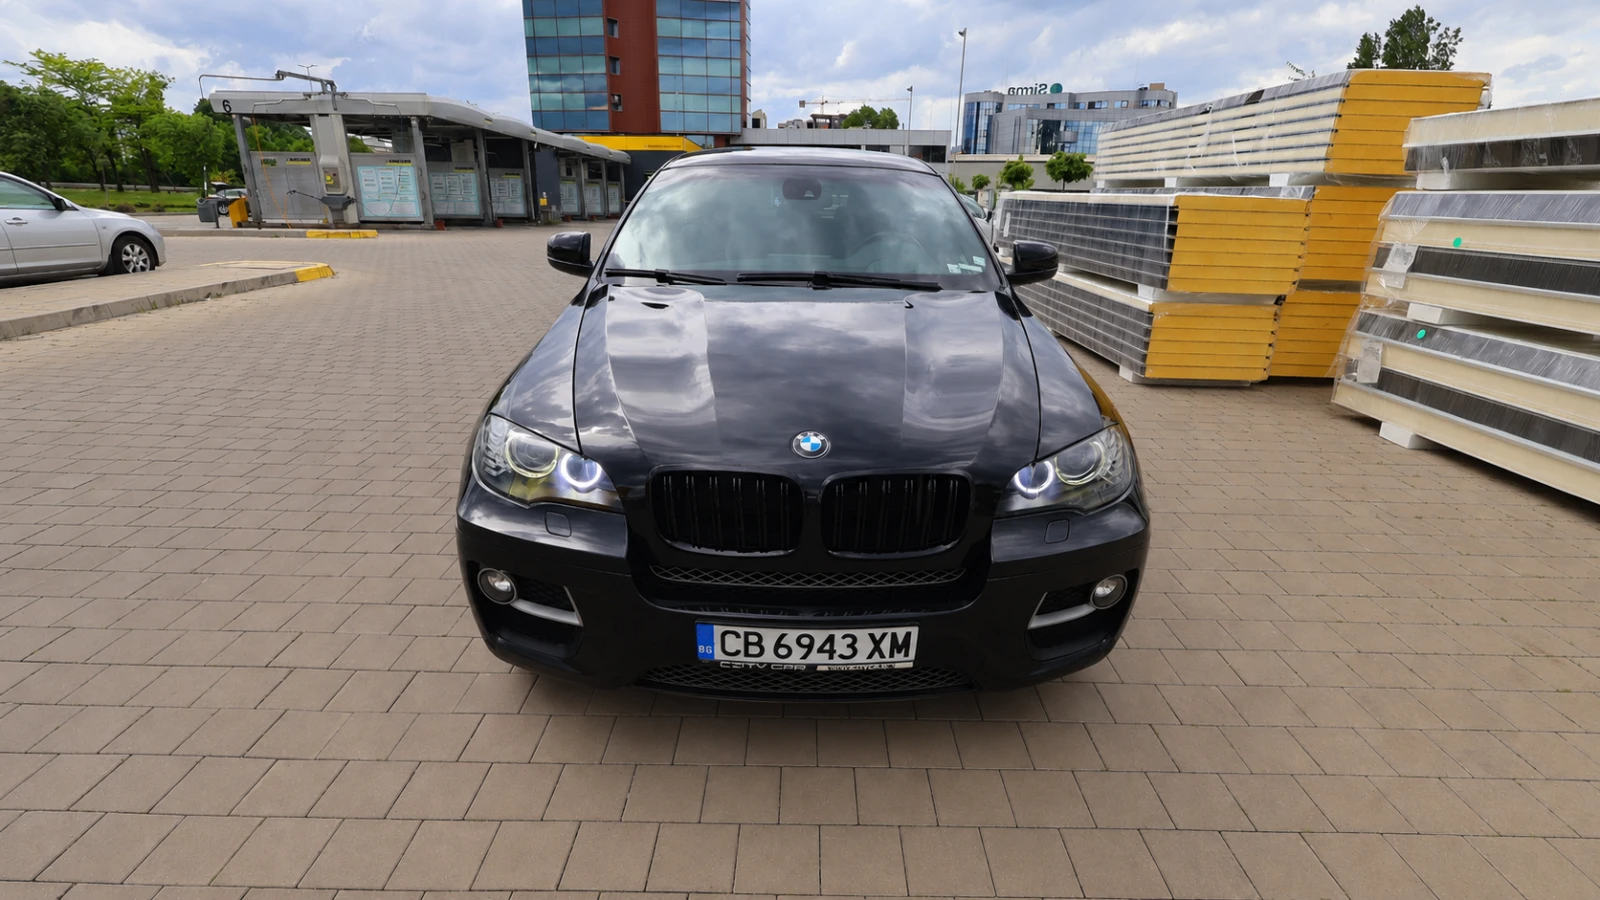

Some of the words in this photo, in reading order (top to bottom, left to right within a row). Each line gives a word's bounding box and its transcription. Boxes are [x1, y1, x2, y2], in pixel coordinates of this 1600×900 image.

[222, 99, 232, 113] 6
[698, 645, 713, 654] BG
[720, 630, 765, 658] CB
[773, 633, 858, 660] 6943
[866, 631, 912, 659] XM
